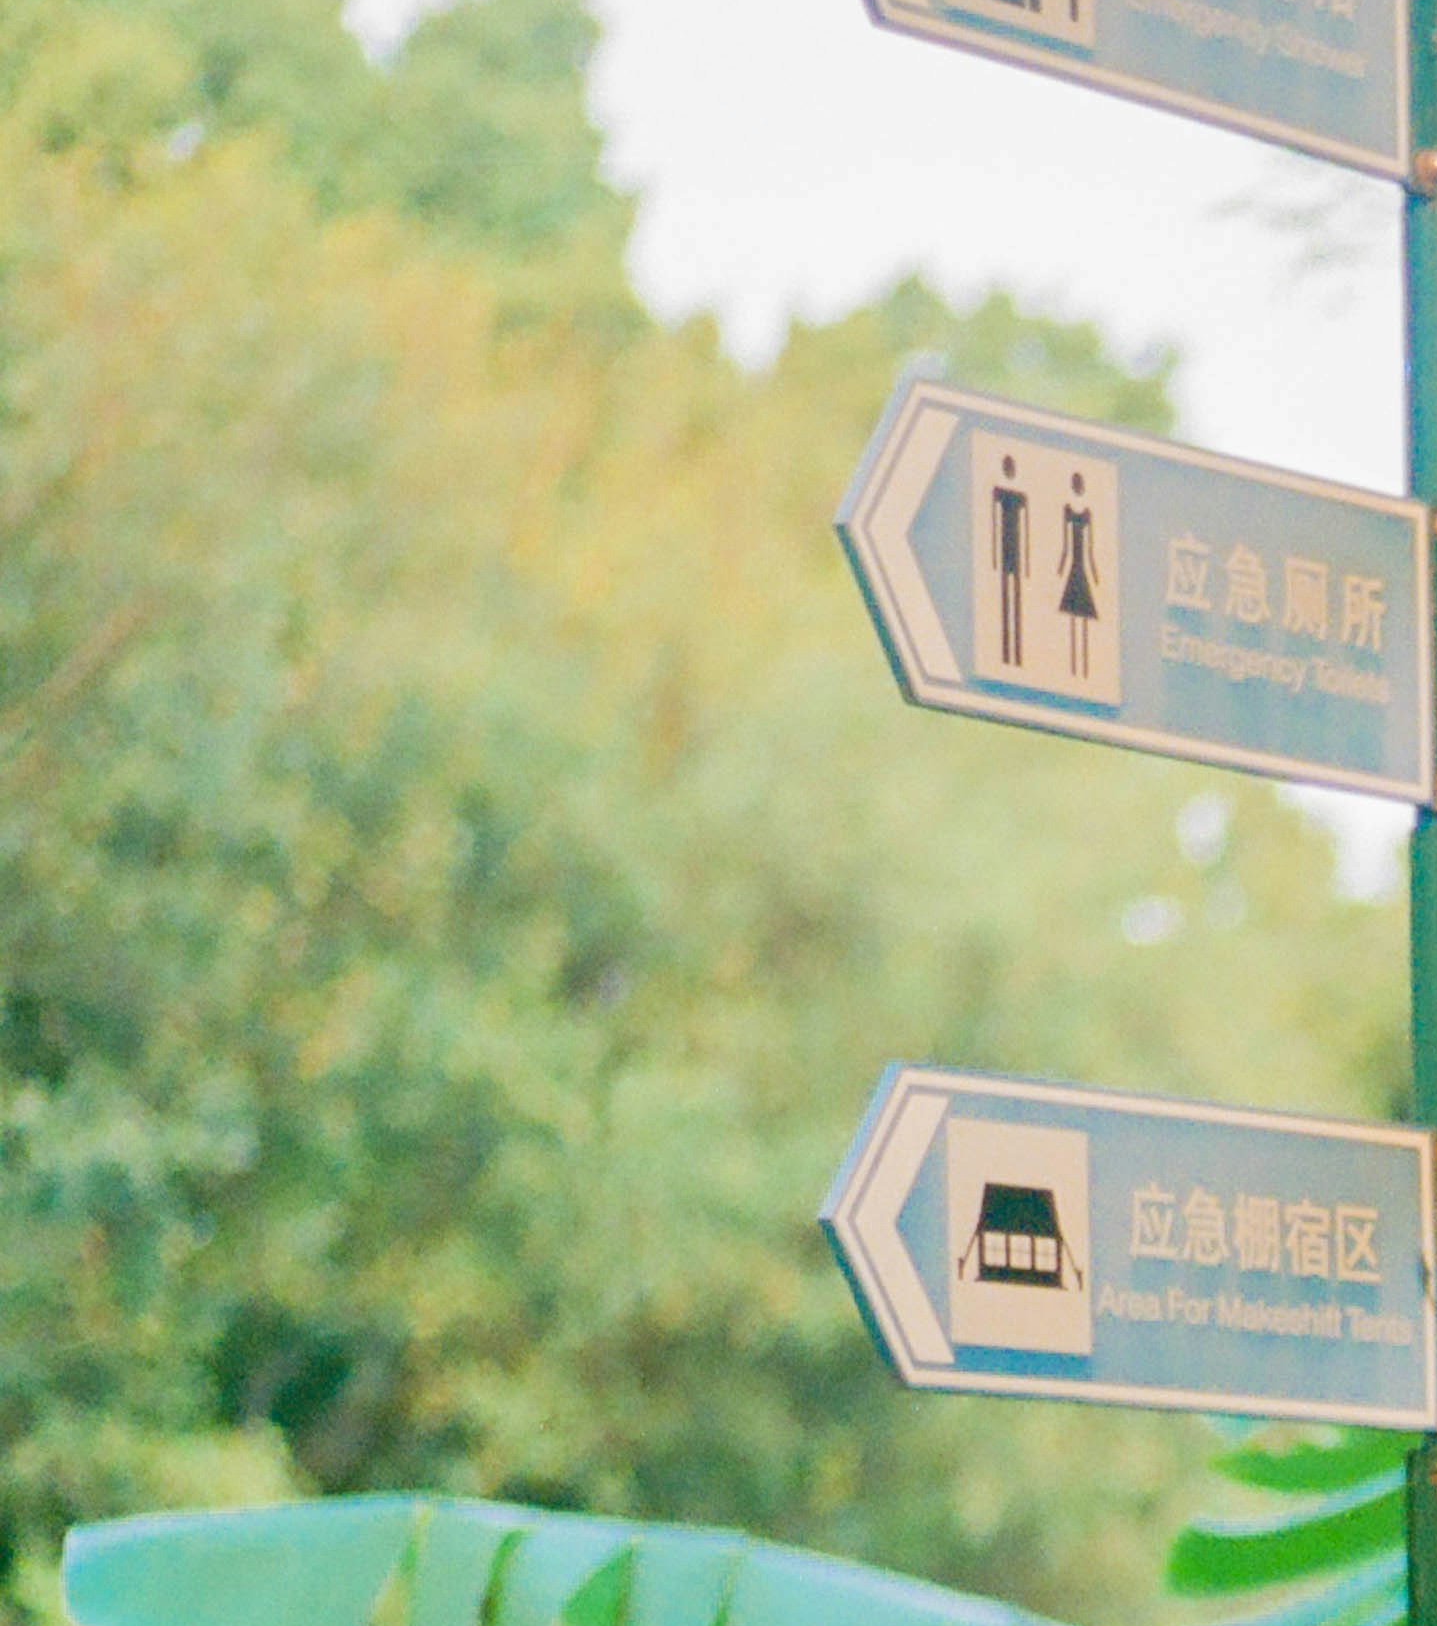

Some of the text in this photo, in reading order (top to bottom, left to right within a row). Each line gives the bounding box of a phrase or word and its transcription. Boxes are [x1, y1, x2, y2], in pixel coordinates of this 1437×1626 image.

[1166, 532, 1387, 651] 应急厕所
[1129, 1180, 1383, 1283] 应急棚宿区
[1097, 1285, 1161, 1323] Area
[1167, 1288, 1212, 1325] For
